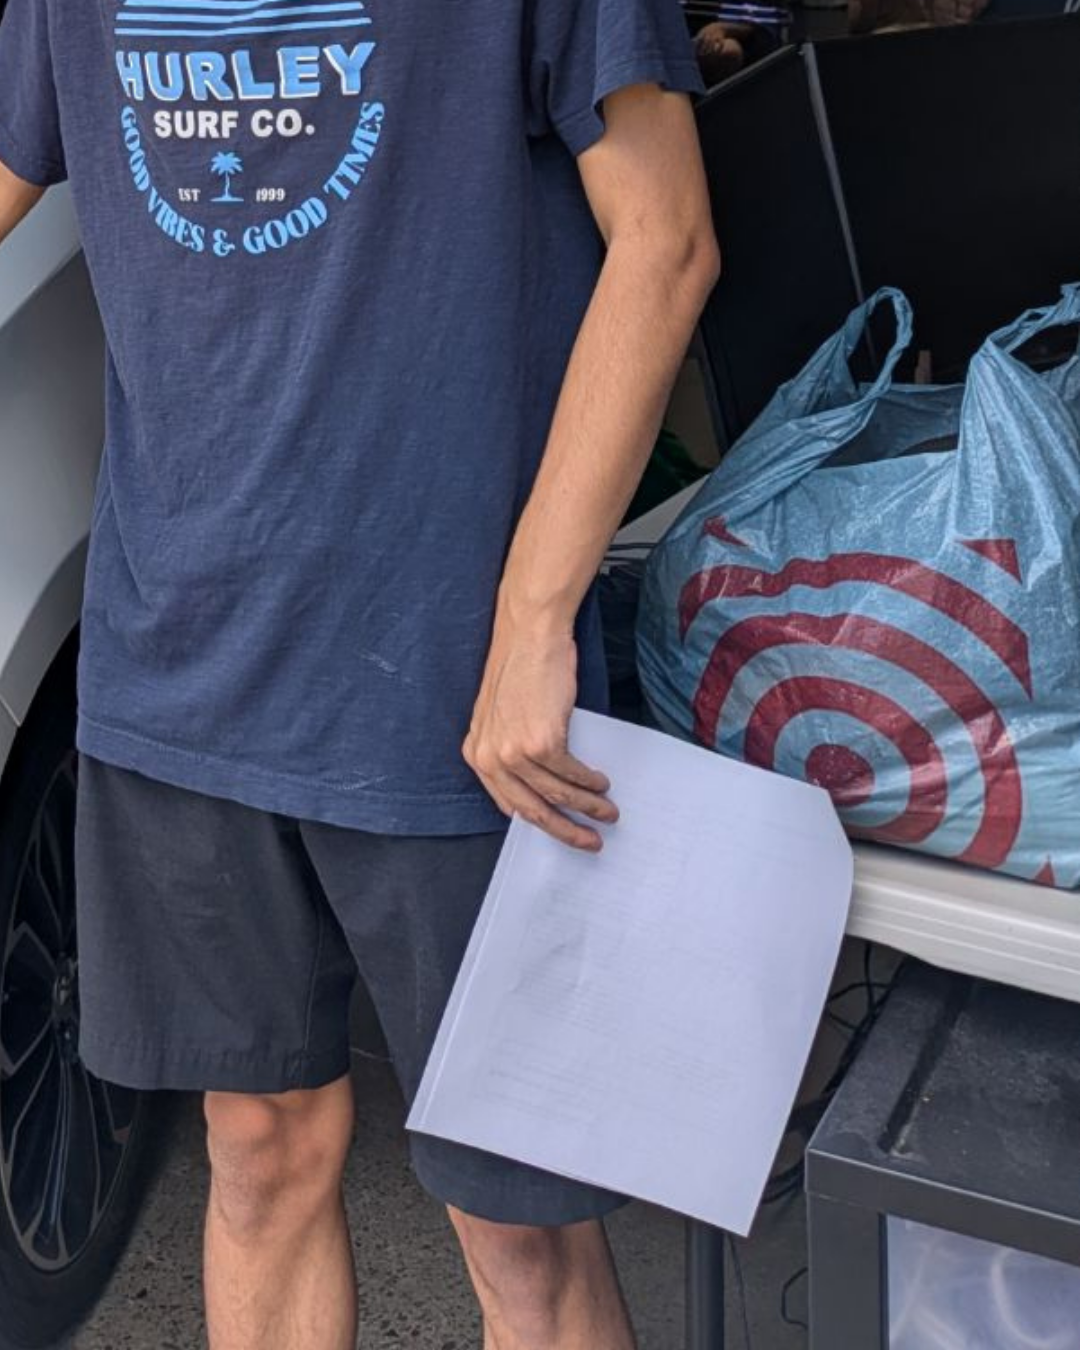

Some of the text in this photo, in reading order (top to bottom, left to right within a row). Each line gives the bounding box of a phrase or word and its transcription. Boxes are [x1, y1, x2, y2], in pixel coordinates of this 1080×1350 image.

[115, 42, 376, 100] HURLEY
[154, 109, 316, 138] SURF CO.
[121, 102, 385, 257] GOOD VIBES & GOOD TIMES
[178, 188, 286, 202] EST 1999
